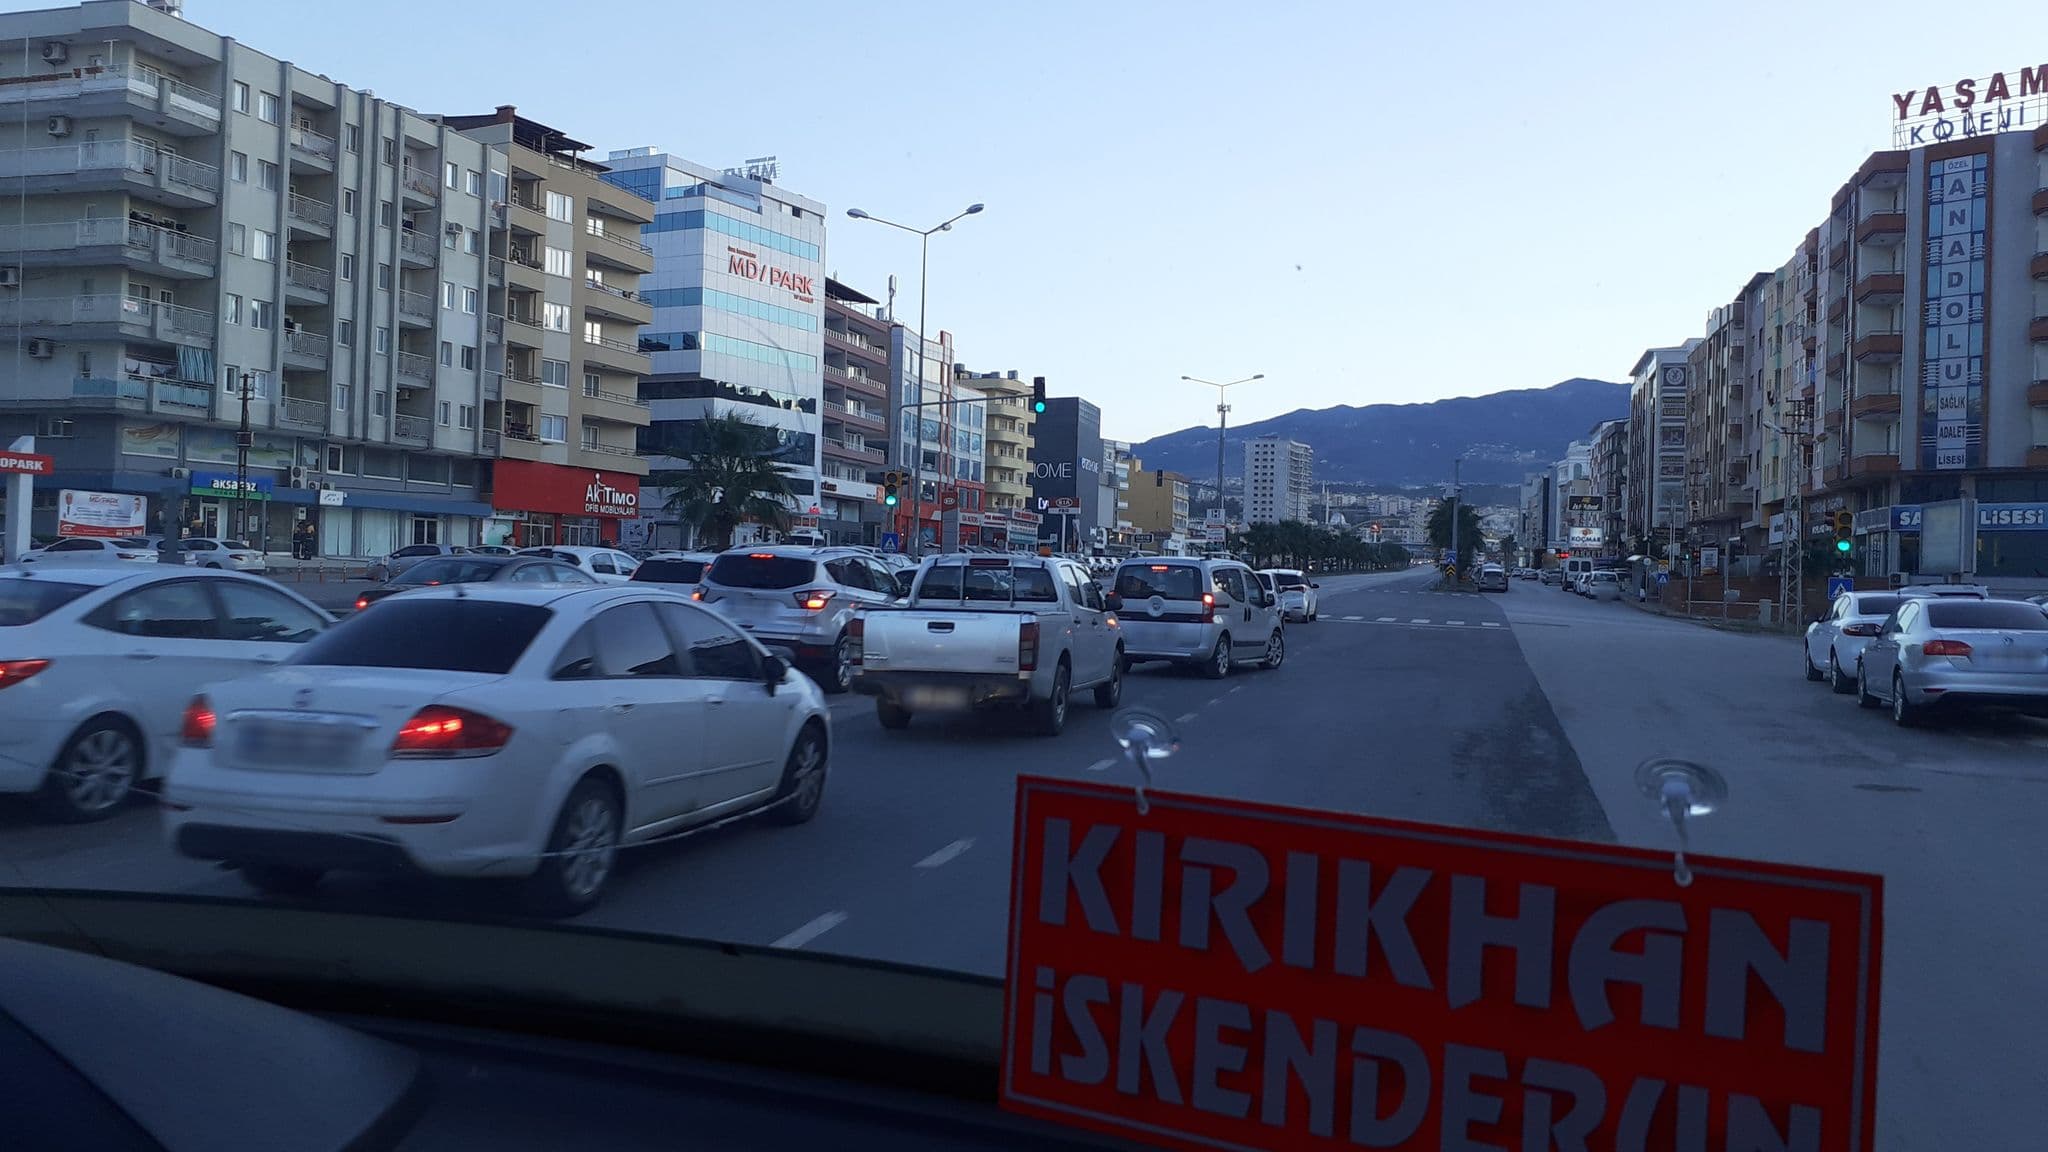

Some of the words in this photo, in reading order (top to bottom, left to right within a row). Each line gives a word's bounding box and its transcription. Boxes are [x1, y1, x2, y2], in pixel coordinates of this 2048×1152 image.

[1892, 63, 2048, 120] YAŞAM
[1910, 101, 2025, 146] KOLEJİ
[1948, 157, 1969, 170] ÖZEL
[1945, 178, 1967, 380] ANADOLU
[1939, 395, 1966, 410] SAĞLIK
[1938, 425, 1966, 439] ADALET
[1938, 455, 1965, 465] LİSESİ
[212, 478, 258, 492] aksaaz
[585, 503, 599, 513] OFİS
[1980, 509, 2044, 525] LİSESİ
[1039, 816, 1831, 1053] KIRIKHAN
